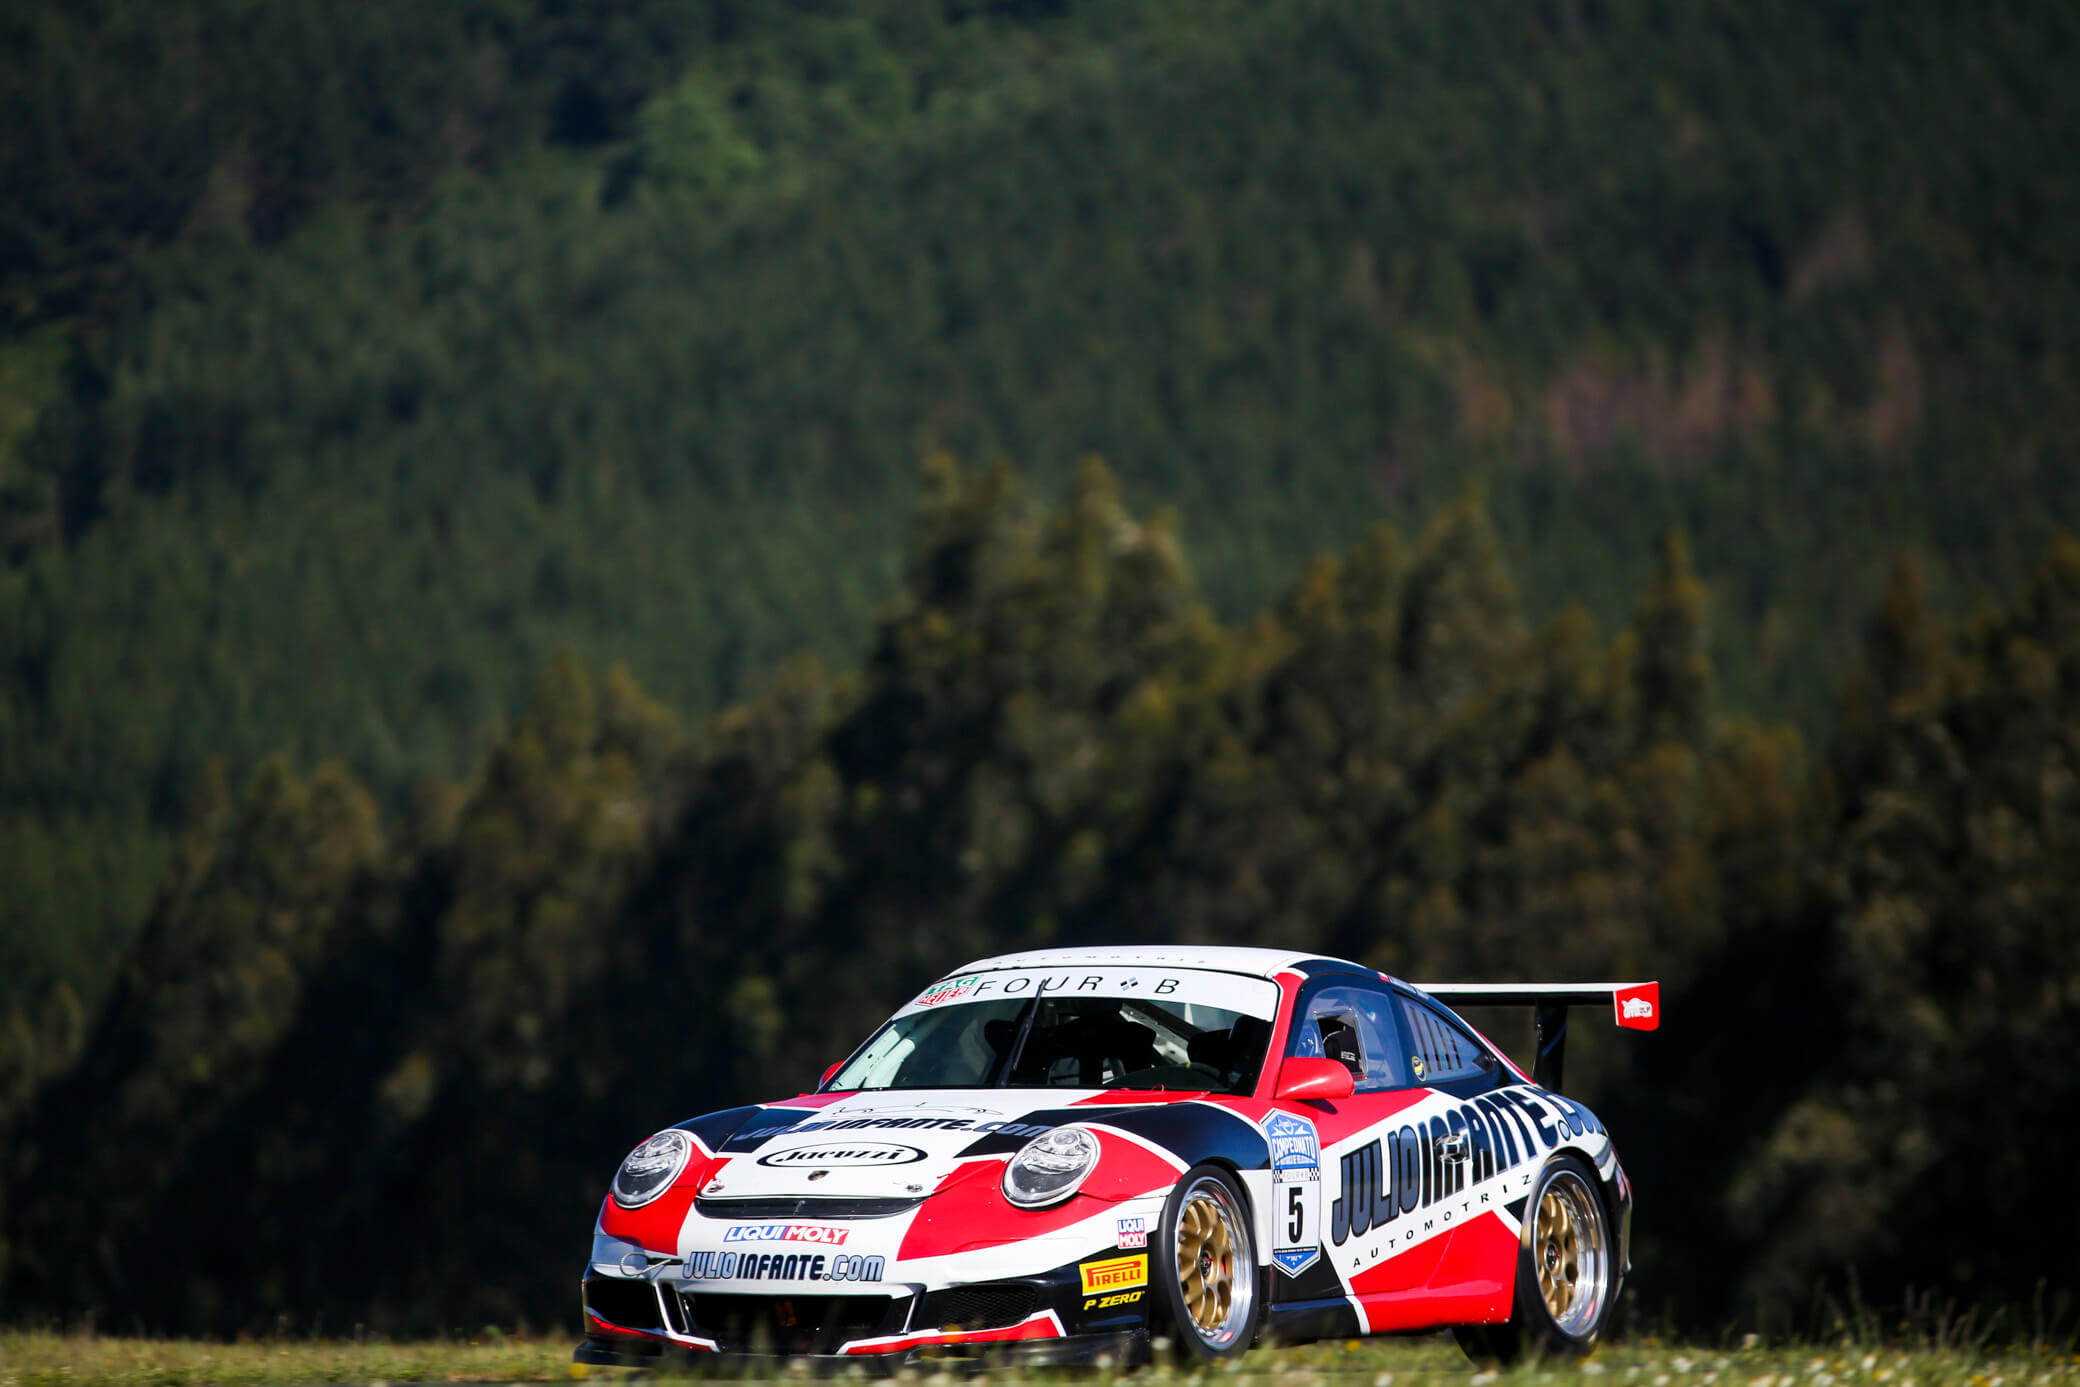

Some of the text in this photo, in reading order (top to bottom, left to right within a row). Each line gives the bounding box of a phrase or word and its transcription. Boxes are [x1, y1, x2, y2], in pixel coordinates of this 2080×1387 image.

[926, 976, 979, 995] TAG
[972, 976, 1180, 996] FOUR B
[775, 1149, 905, 1163] Jacuzzi
[1288, 1186, 1304, 1244] 5
[1352, 1174, 1533, 1268] AUTOMOTRIZ
[725, 1226, 850, 1245] LIQUI MOLY
[1118, 1232, 1146, 1247] MOLY
[1085, 1260, 1142, 1288] PIRELLI
[1083, 1291, 1142, 1311] P ZERO
